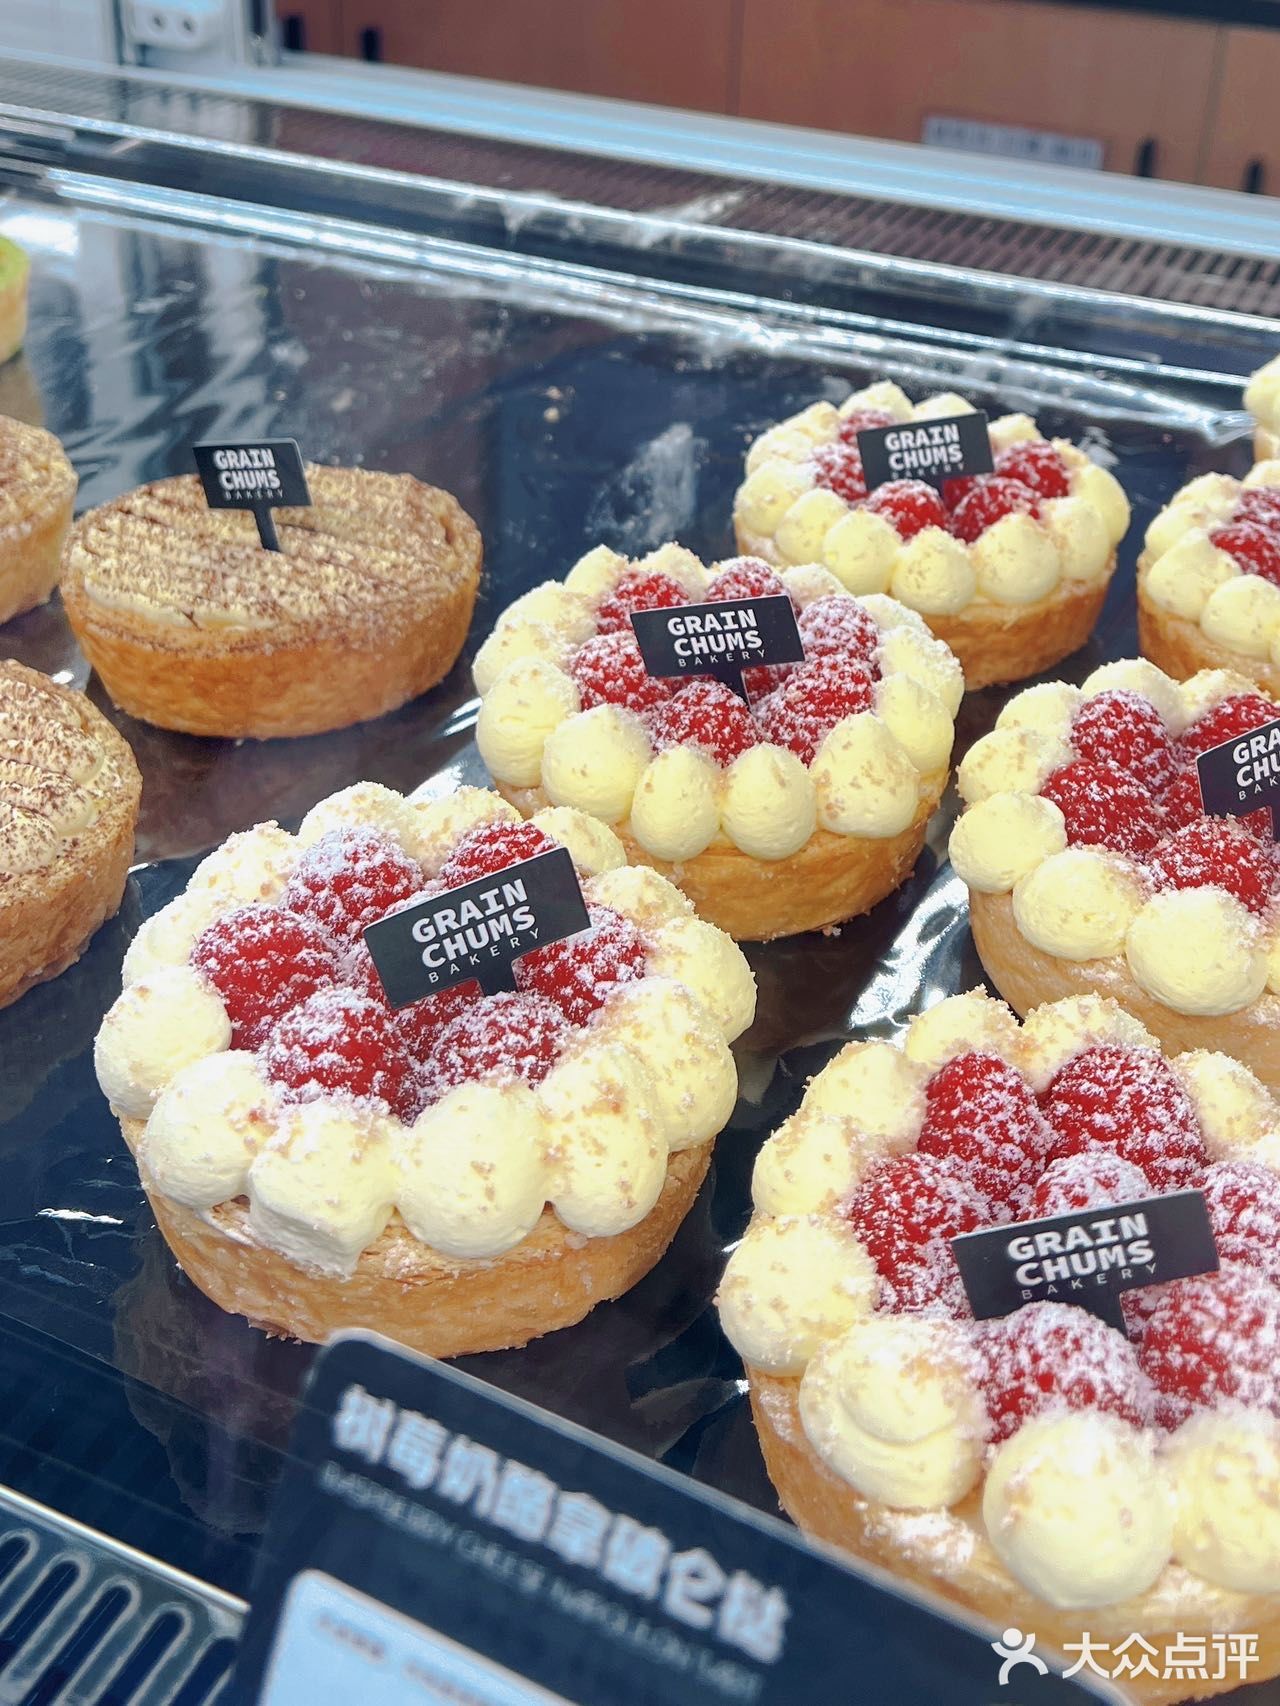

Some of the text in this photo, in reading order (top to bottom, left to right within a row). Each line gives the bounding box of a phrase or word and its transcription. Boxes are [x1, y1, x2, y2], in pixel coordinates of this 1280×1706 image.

[884, 423, 960, 451] GRAIN
[214, 448, 275, 470] GRAIN
[888, 443, 963, 471] CHUMS
[890, 461, 964, 480] BAKERY
[220, 469, 281, 490] CHUMS
[225, 489, 283, 500] BAKERY
[667, 608, 758, 636] GRAIN
[673, 630, 763, 657] CHUMS
[678, 649, 766, 667] BAKERY
[1238, 776, 1278, 801] BAK
[412, 878, 528, 943] GRAIN
[421, 905, 536, 968] CHUMS
[428, 928, 540, 984] BAKERY
[1007, 1212, 1149, 1262] GRAIN
[1015, 1240, 1155, 1286] CHUMS
[1022, 1264, 1157, 1300] BAKERY
